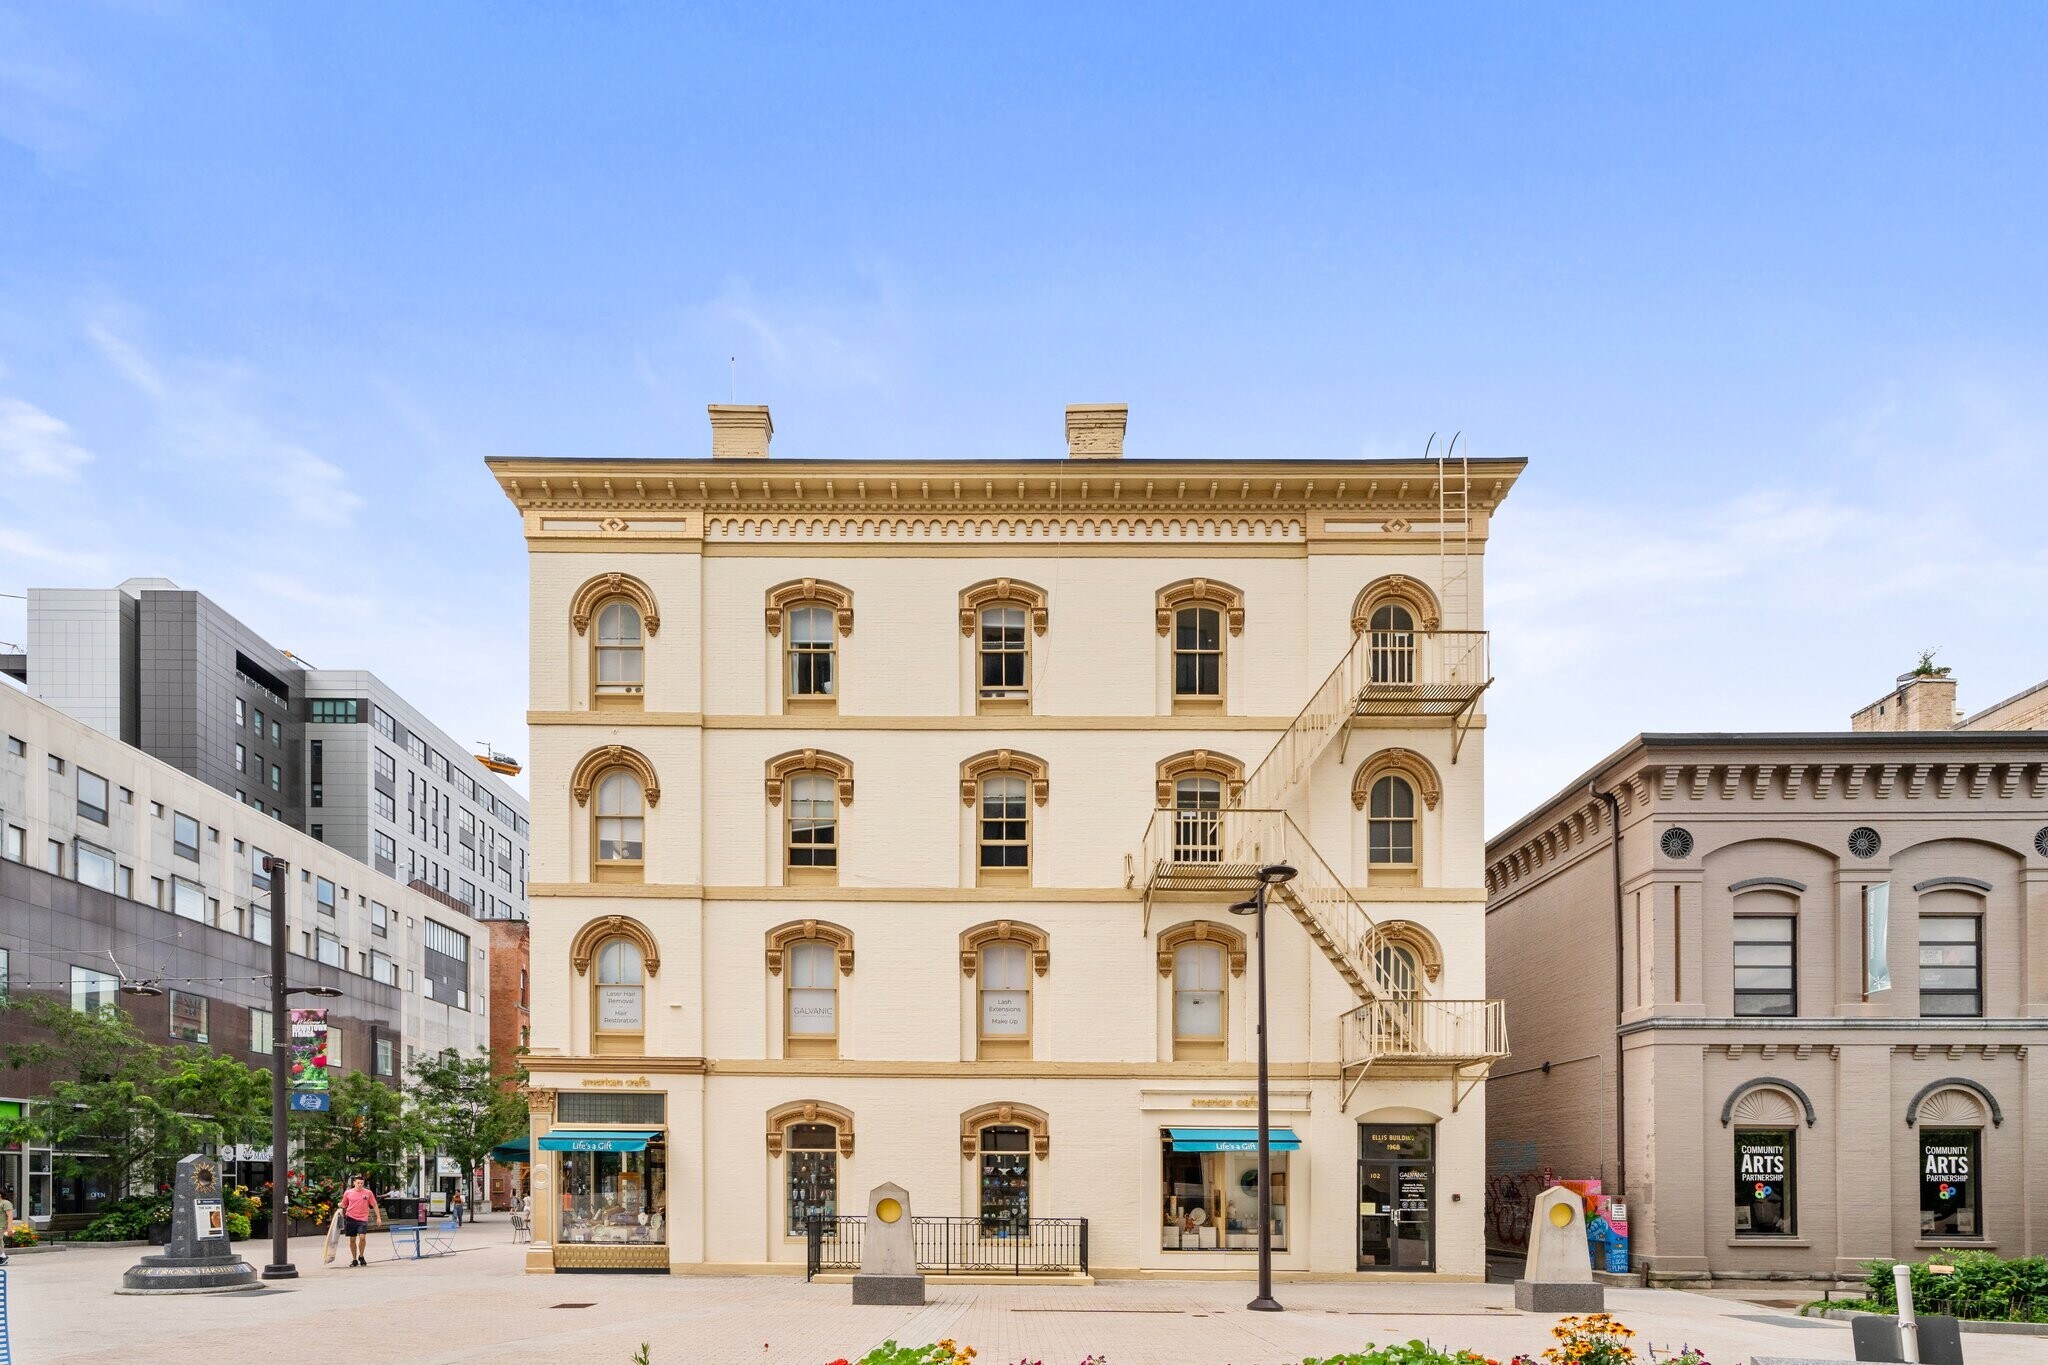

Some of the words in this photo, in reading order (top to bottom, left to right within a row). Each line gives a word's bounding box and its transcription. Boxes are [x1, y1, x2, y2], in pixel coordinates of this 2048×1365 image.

[794, 1007, 833, 1015] GALVANIC
[581, 1078, 623, 1087] american
[625, 1075, 651, 1087] crafts
[1191, 1098, 1233, 1107] american
[572, 1140, 591, 1150] Life's
[597, 1140, 613, 1150] Gift
[1216, 1141, 1235, 1150] Life's
[1241, 1142, 1257, 1150] Gift
[1741, 1145, 1784, 1154] COMMUNITY
[1925, 1145, 1968, 1155] COMMUNITY
[1741, 1153, 1784, 1174] ARTS
[1925, 1154, 1969, 1174] ARTS
[1741, 1173, 1784, 1182] PARTNERSHIP
[1926, 1174, 1968, 1182] PARTNERSHIP
[90, 1191, 106, 1199] OPEN
